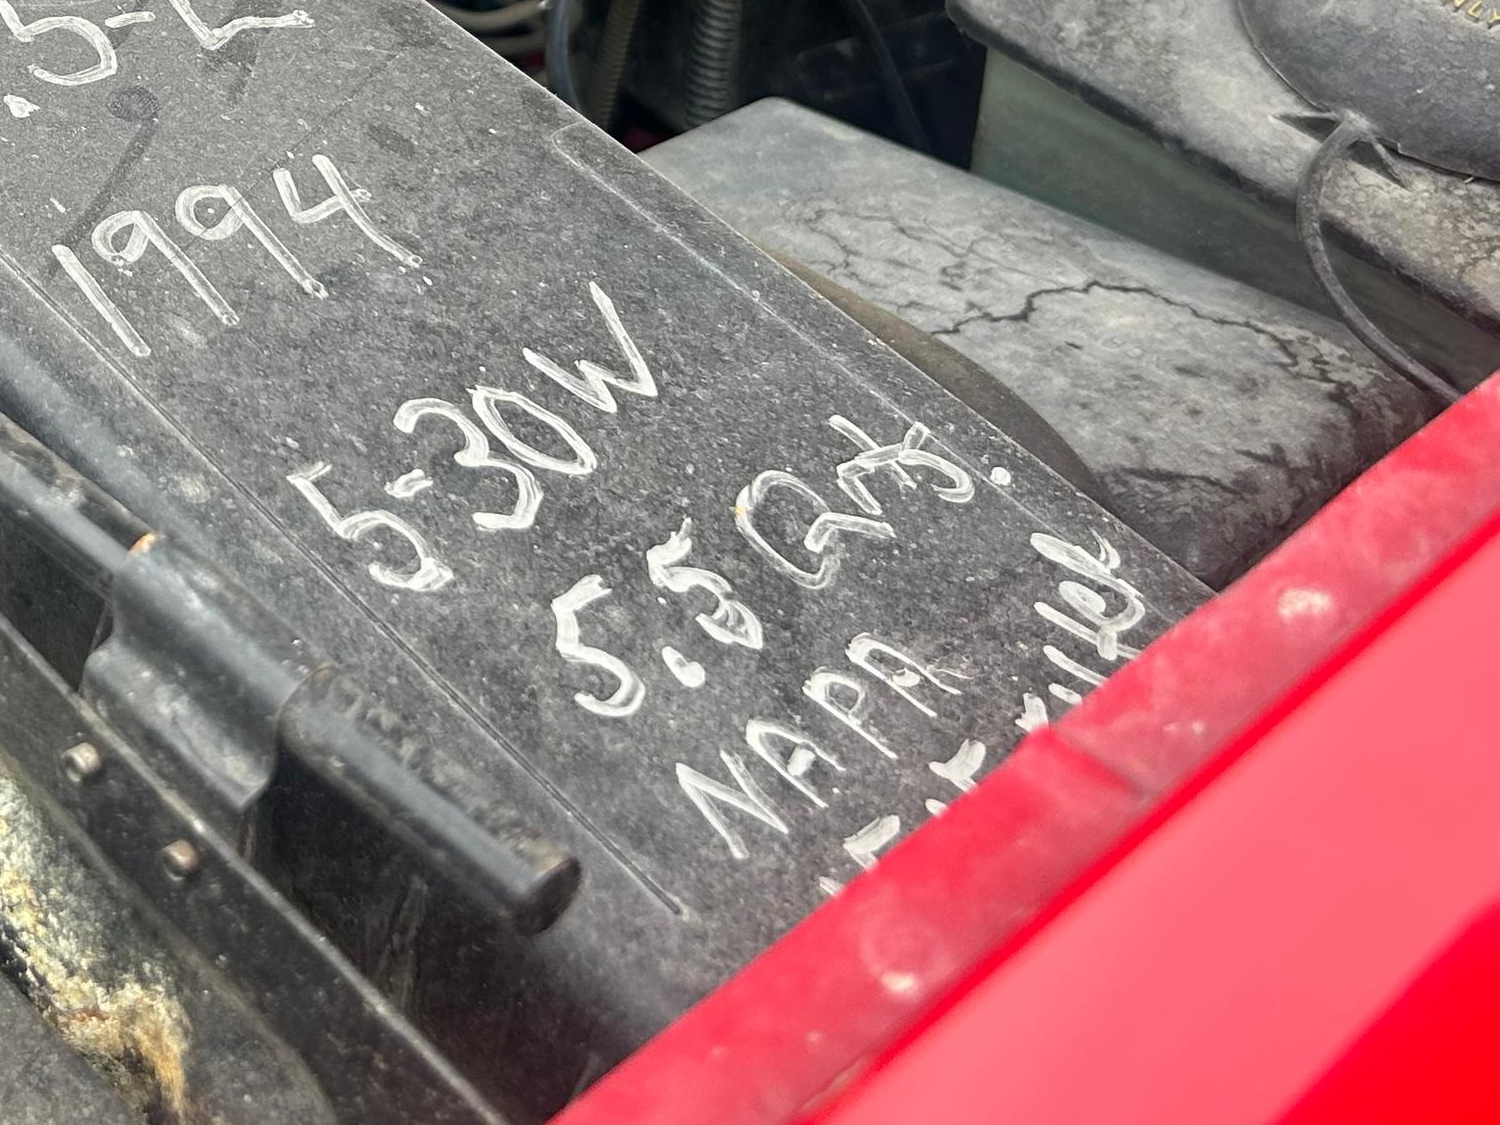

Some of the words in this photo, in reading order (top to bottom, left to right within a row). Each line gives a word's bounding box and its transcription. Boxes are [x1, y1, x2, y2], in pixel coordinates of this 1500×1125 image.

[52, 154, 424, 357] 1994
[287, 281, 658, 592] 5-30W
[675, 631, 964, 859] NAPA
